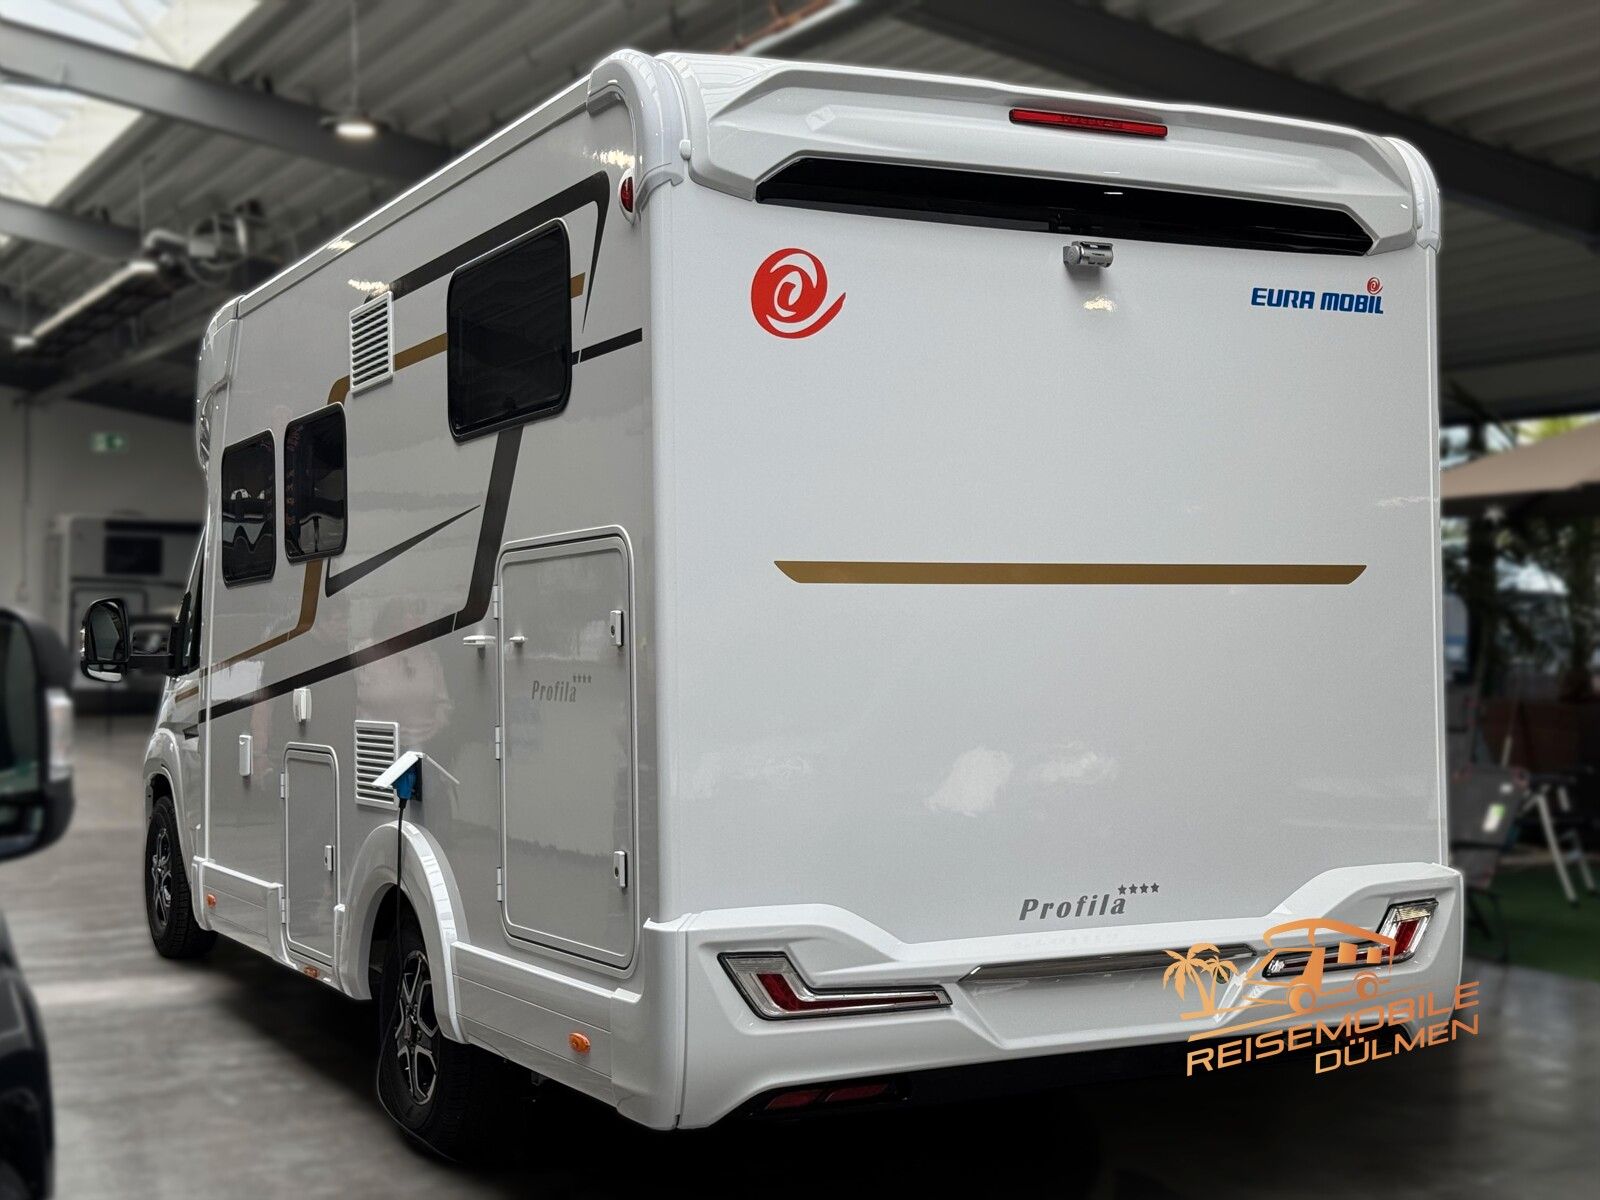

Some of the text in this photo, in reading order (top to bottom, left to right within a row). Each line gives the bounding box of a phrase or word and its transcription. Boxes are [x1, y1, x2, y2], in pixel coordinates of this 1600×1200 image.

[1251, 287, 1383, 314] EURA MOBIL
[531, 680, 576, 702] Profila
[1019, 894, 1126, 920] Profila
